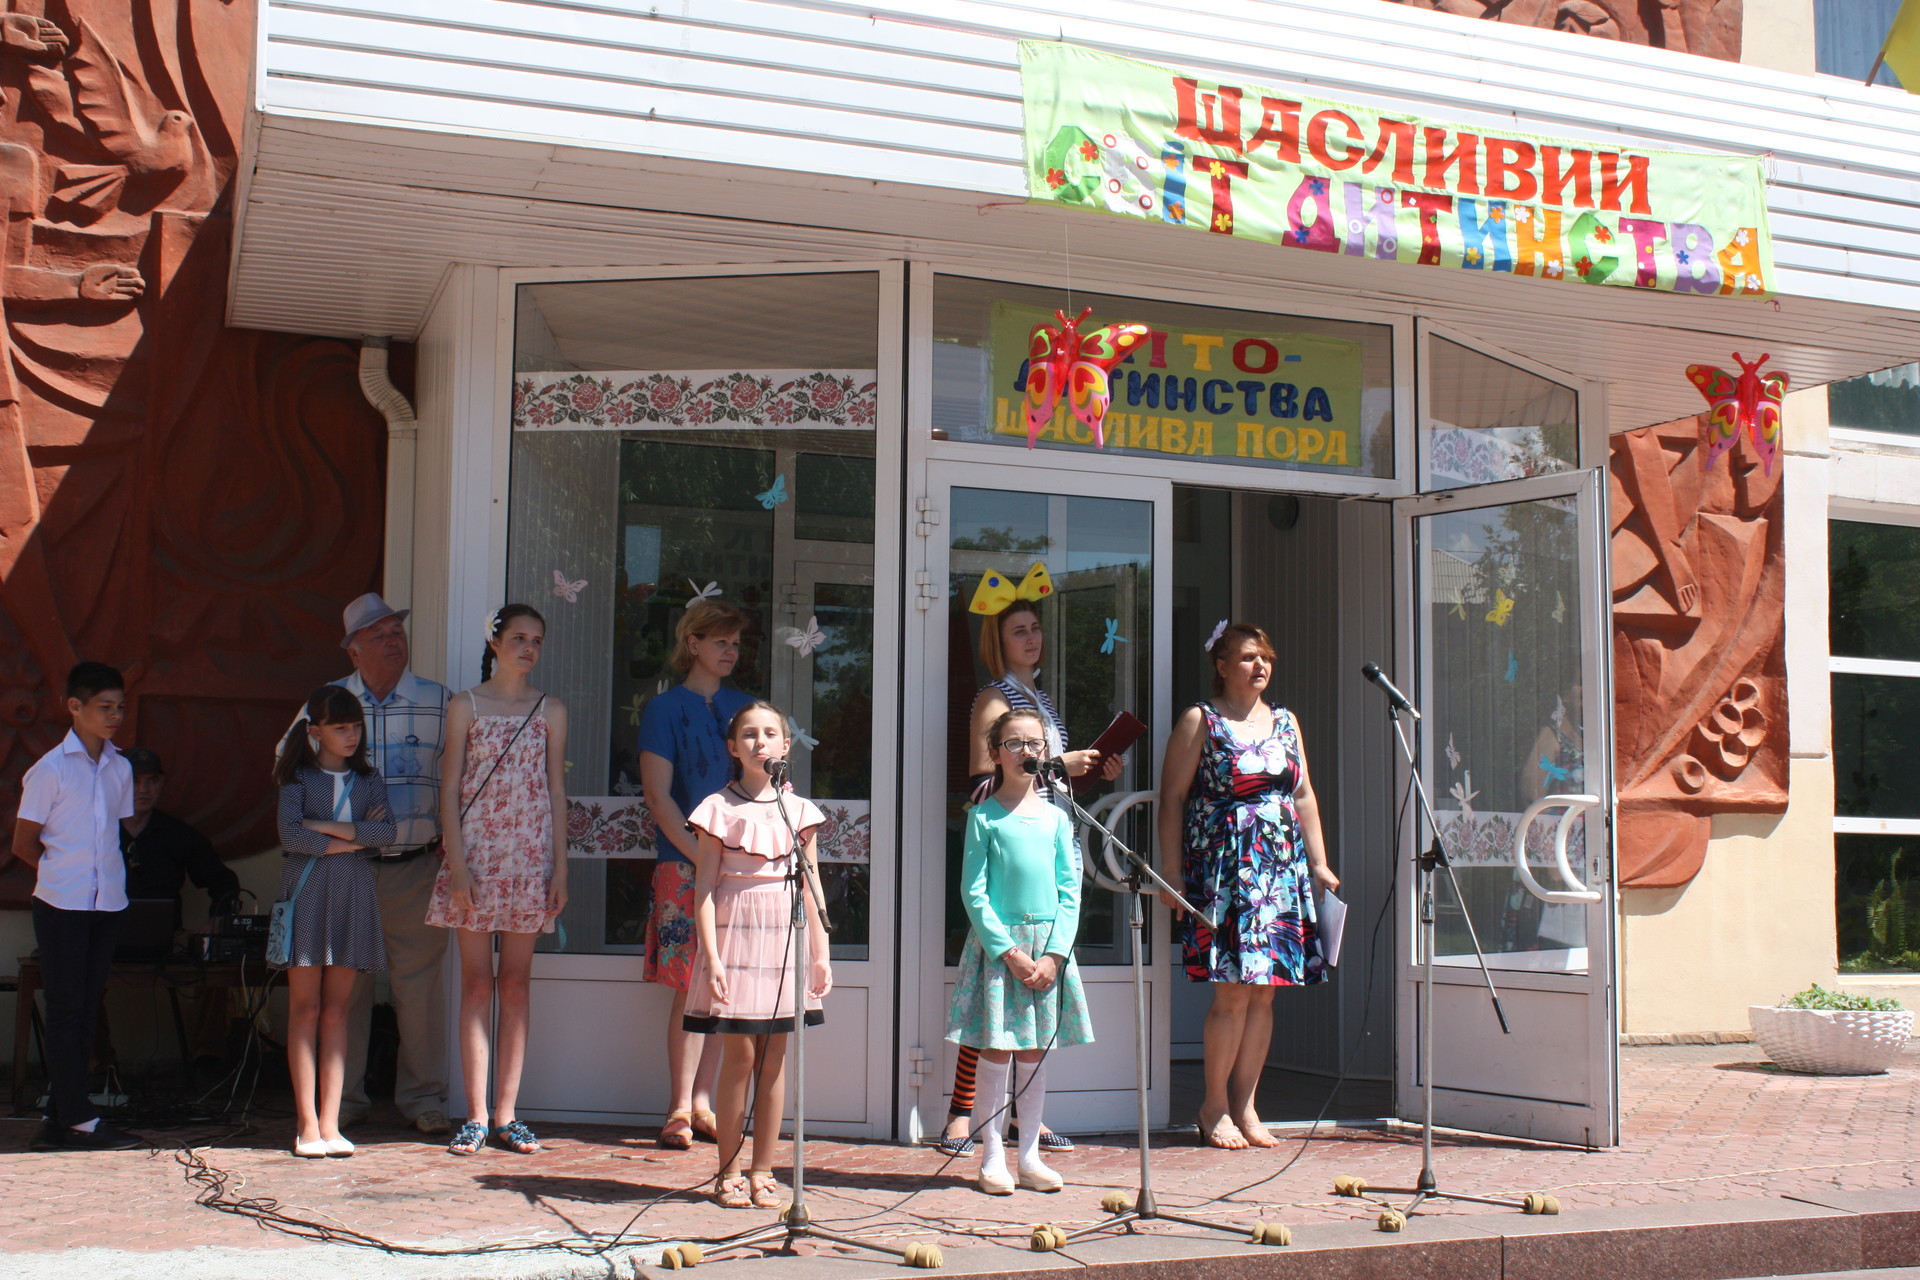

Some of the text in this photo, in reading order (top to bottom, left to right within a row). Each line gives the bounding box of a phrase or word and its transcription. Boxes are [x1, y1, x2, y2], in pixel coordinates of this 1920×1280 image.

[1044, 125, 1766, 296] СВІТ ДИТИНСТВА
[1100, 323, 1302, 375] ІТО-
[1013, 358, 1333, 423] ИНСТВА
[1236, 422, 1348, 465] ПОРА
